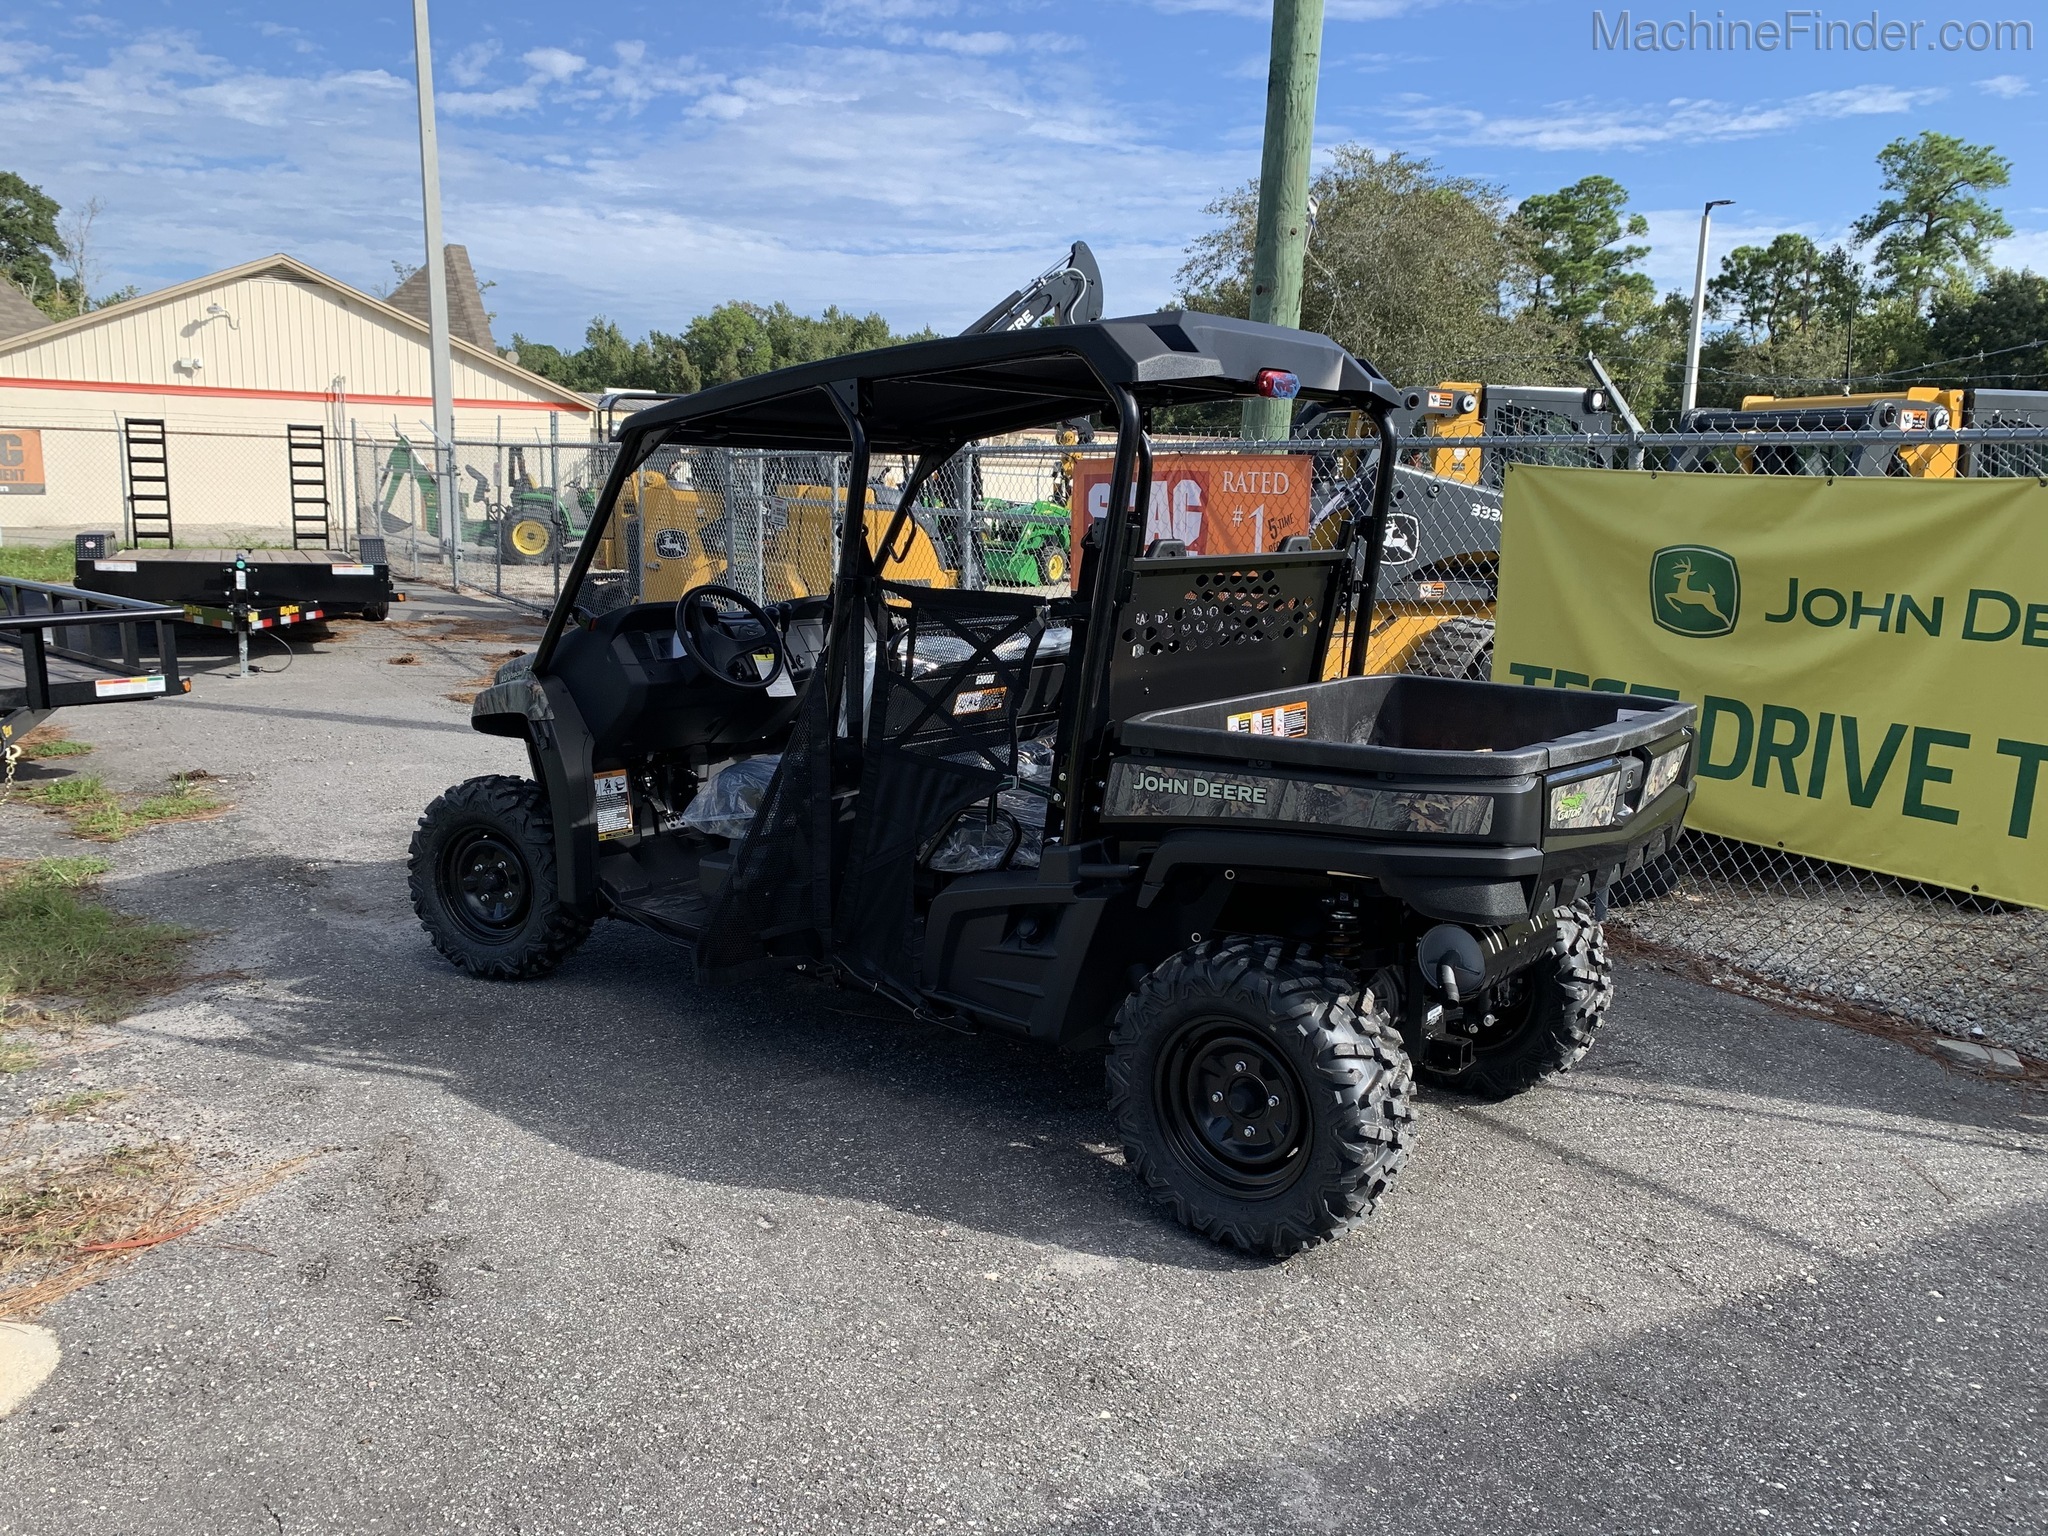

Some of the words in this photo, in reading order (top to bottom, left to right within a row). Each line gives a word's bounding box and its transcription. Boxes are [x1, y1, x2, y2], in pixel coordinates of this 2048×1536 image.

[1222, 470, 1291, 496] RATED
[1471, 503, 1503, 523] 333
[1764, 577, 1945, 637] JOHN
[1697, 694, 1972, 826] DRIVE
[1133, 772, 1188, 795] JOHN
[1193, 778, 1268, 804] DEERE
[1557, 807, 1583, 821] GATOR
